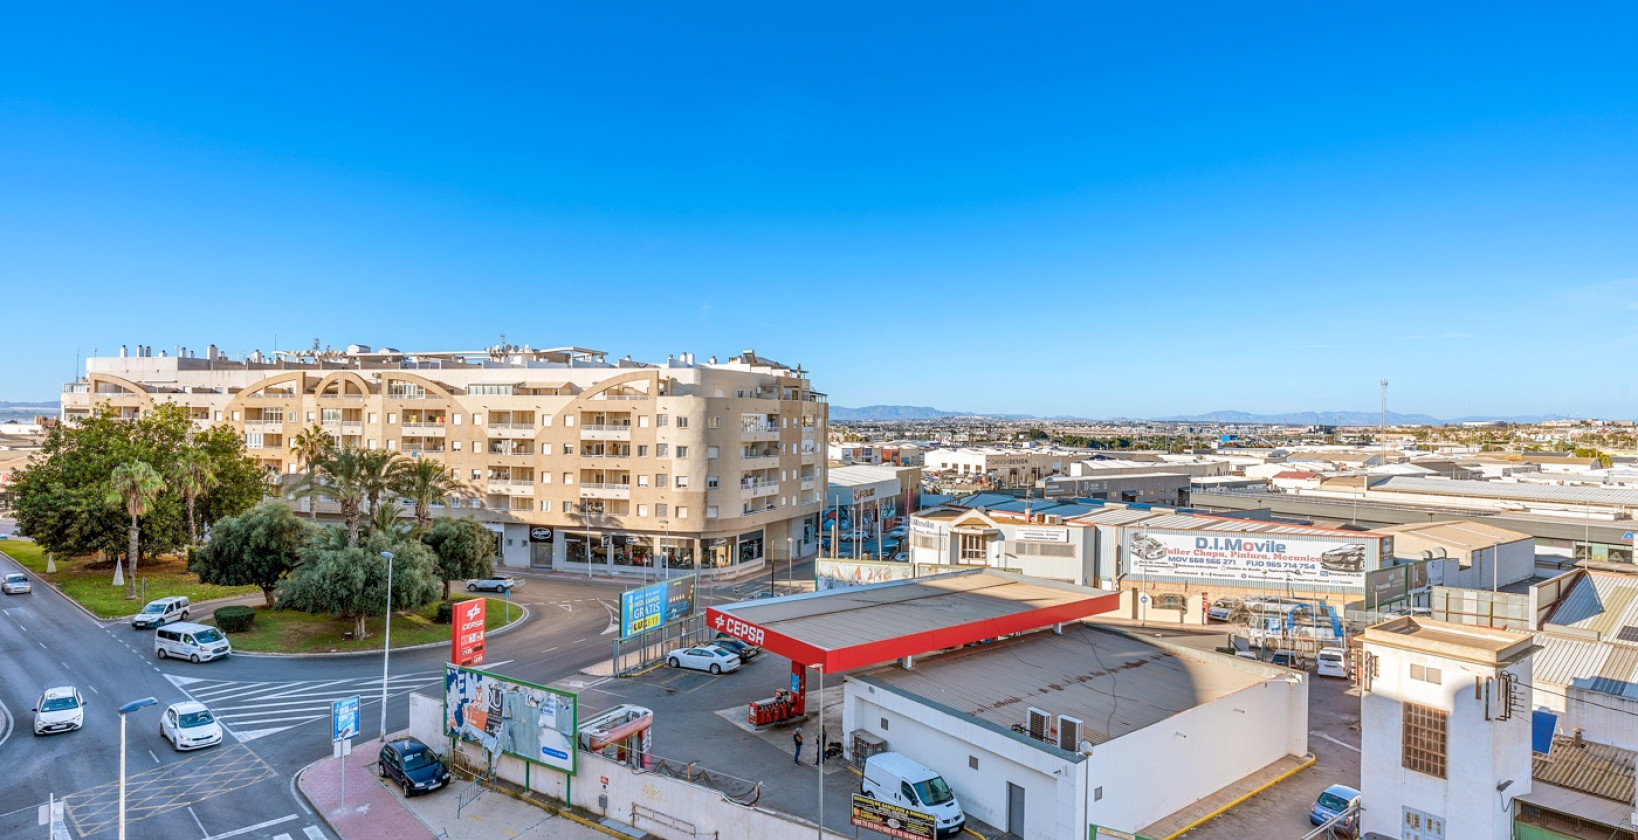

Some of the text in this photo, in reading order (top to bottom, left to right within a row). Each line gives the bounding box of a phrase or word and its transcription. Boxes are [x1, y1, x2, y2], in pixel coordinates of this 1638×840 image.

[1162, 547, 1191, 556] Taller
[1195, 536, 1287, 554] D.I.Movile
[1246, 559, 1264, 567] FIJO
[633, 602, 660, 619] GRATIS
[726, 618, 765, 645] CEPSA
